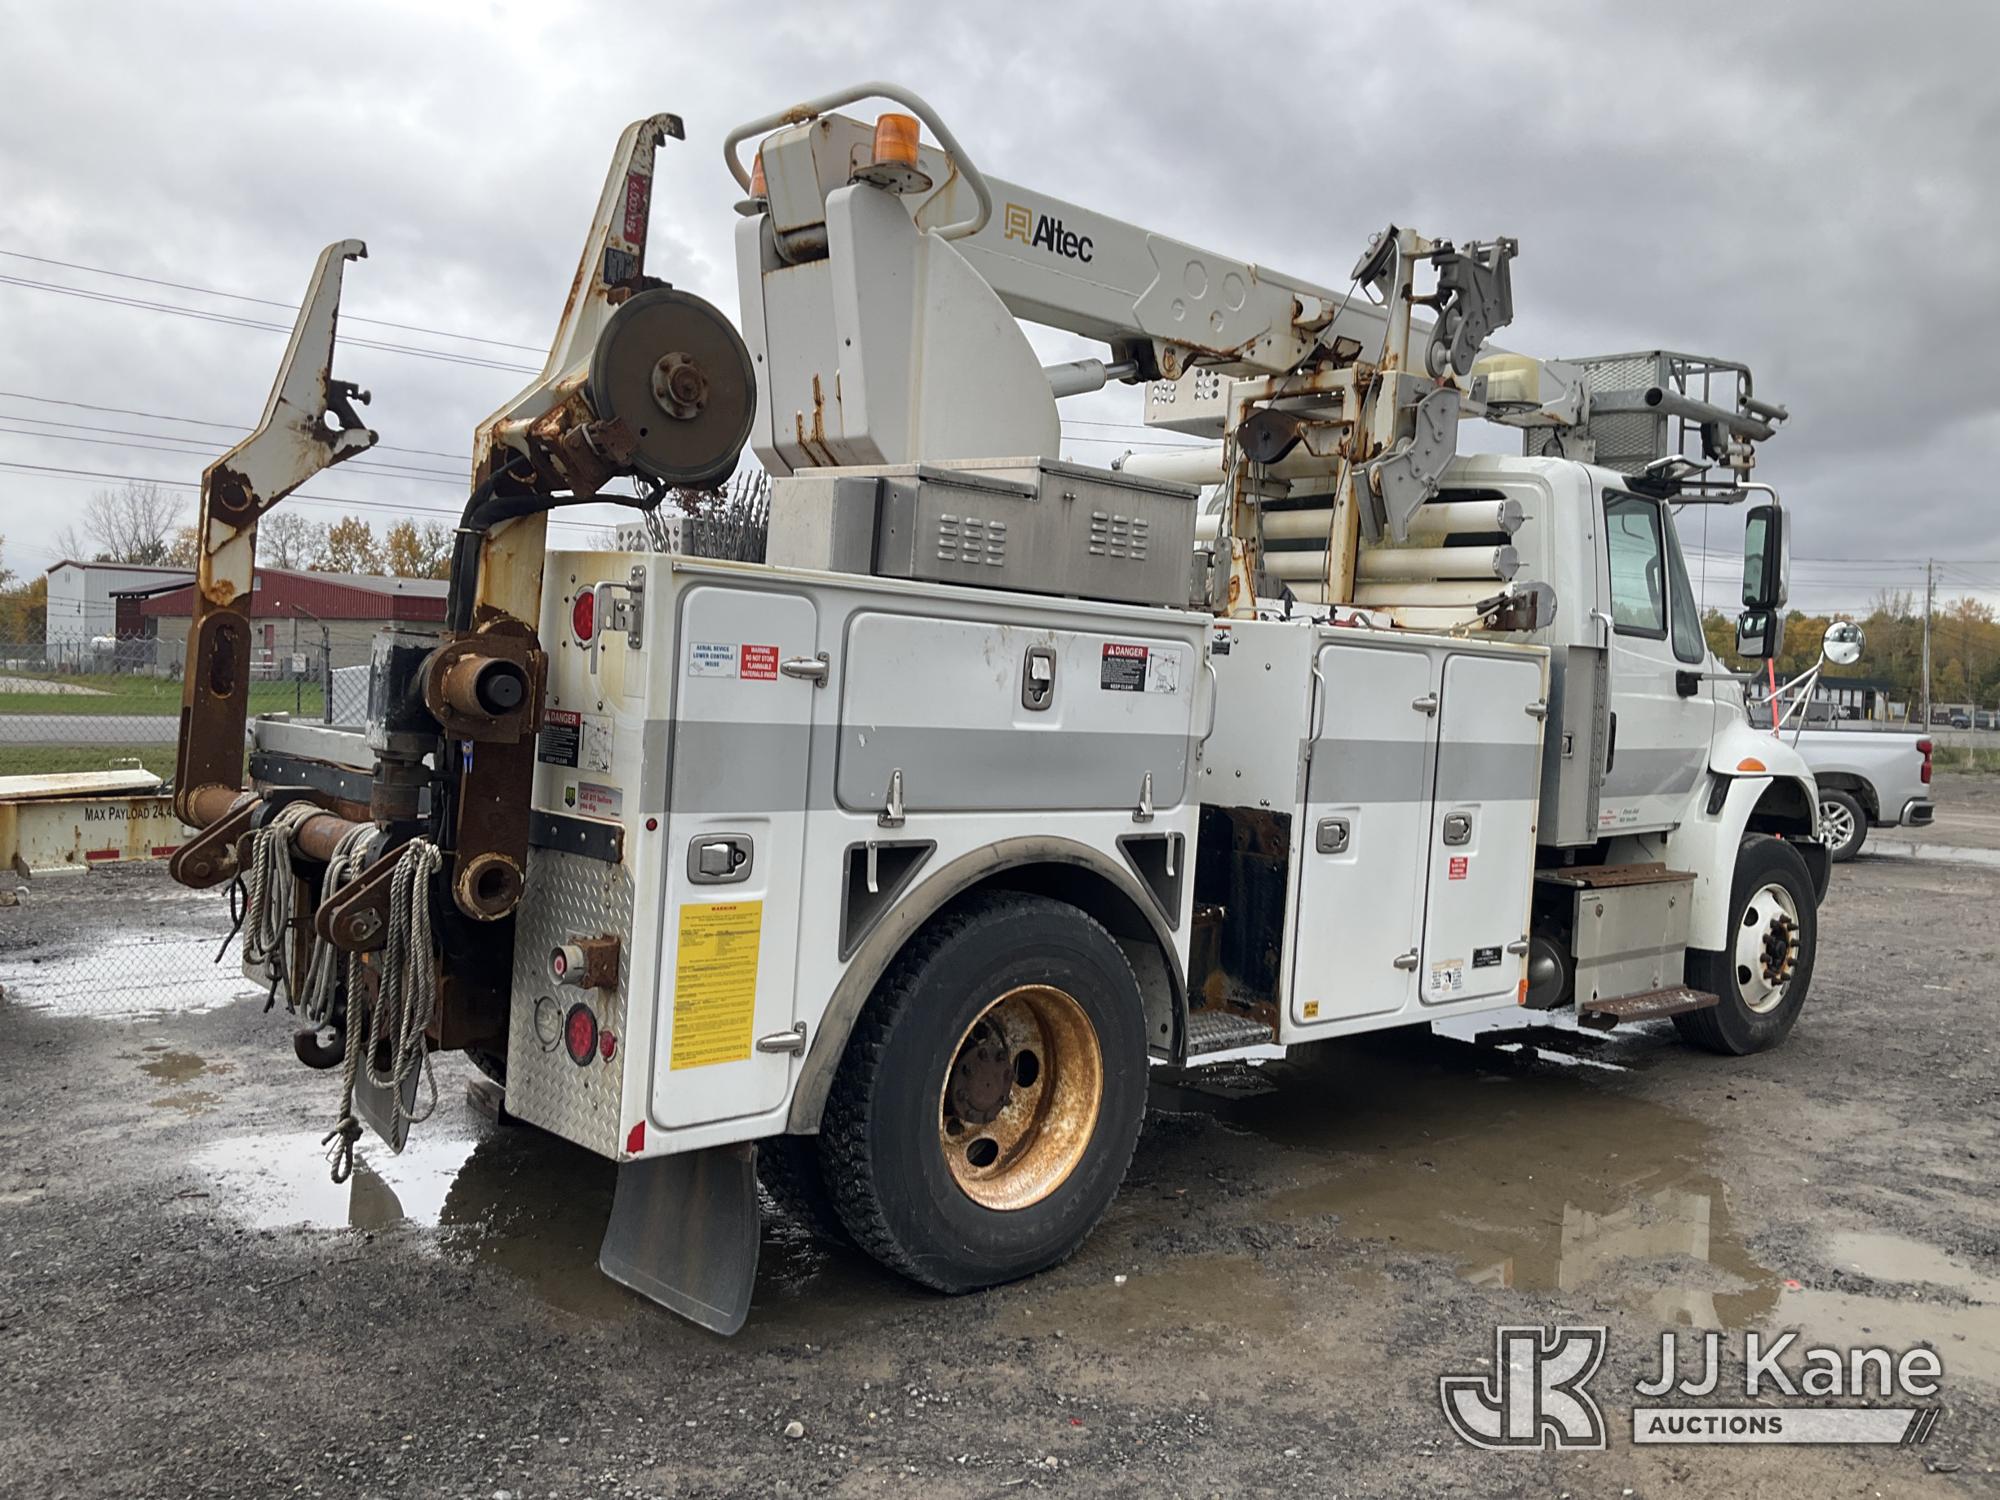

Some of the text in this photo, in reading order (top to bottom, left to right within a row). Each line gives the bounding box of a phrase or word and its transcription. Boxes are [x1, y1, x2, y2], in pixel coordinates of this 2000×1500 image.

[1032, 213, 1094, 263] Altec
[1115, 646, 1144, 657] DANGER
[550, 711, 577, 725] DANGER
[85, 808, 106, 821] MAX
[108, 806, 150, 820] PAYLOAD
